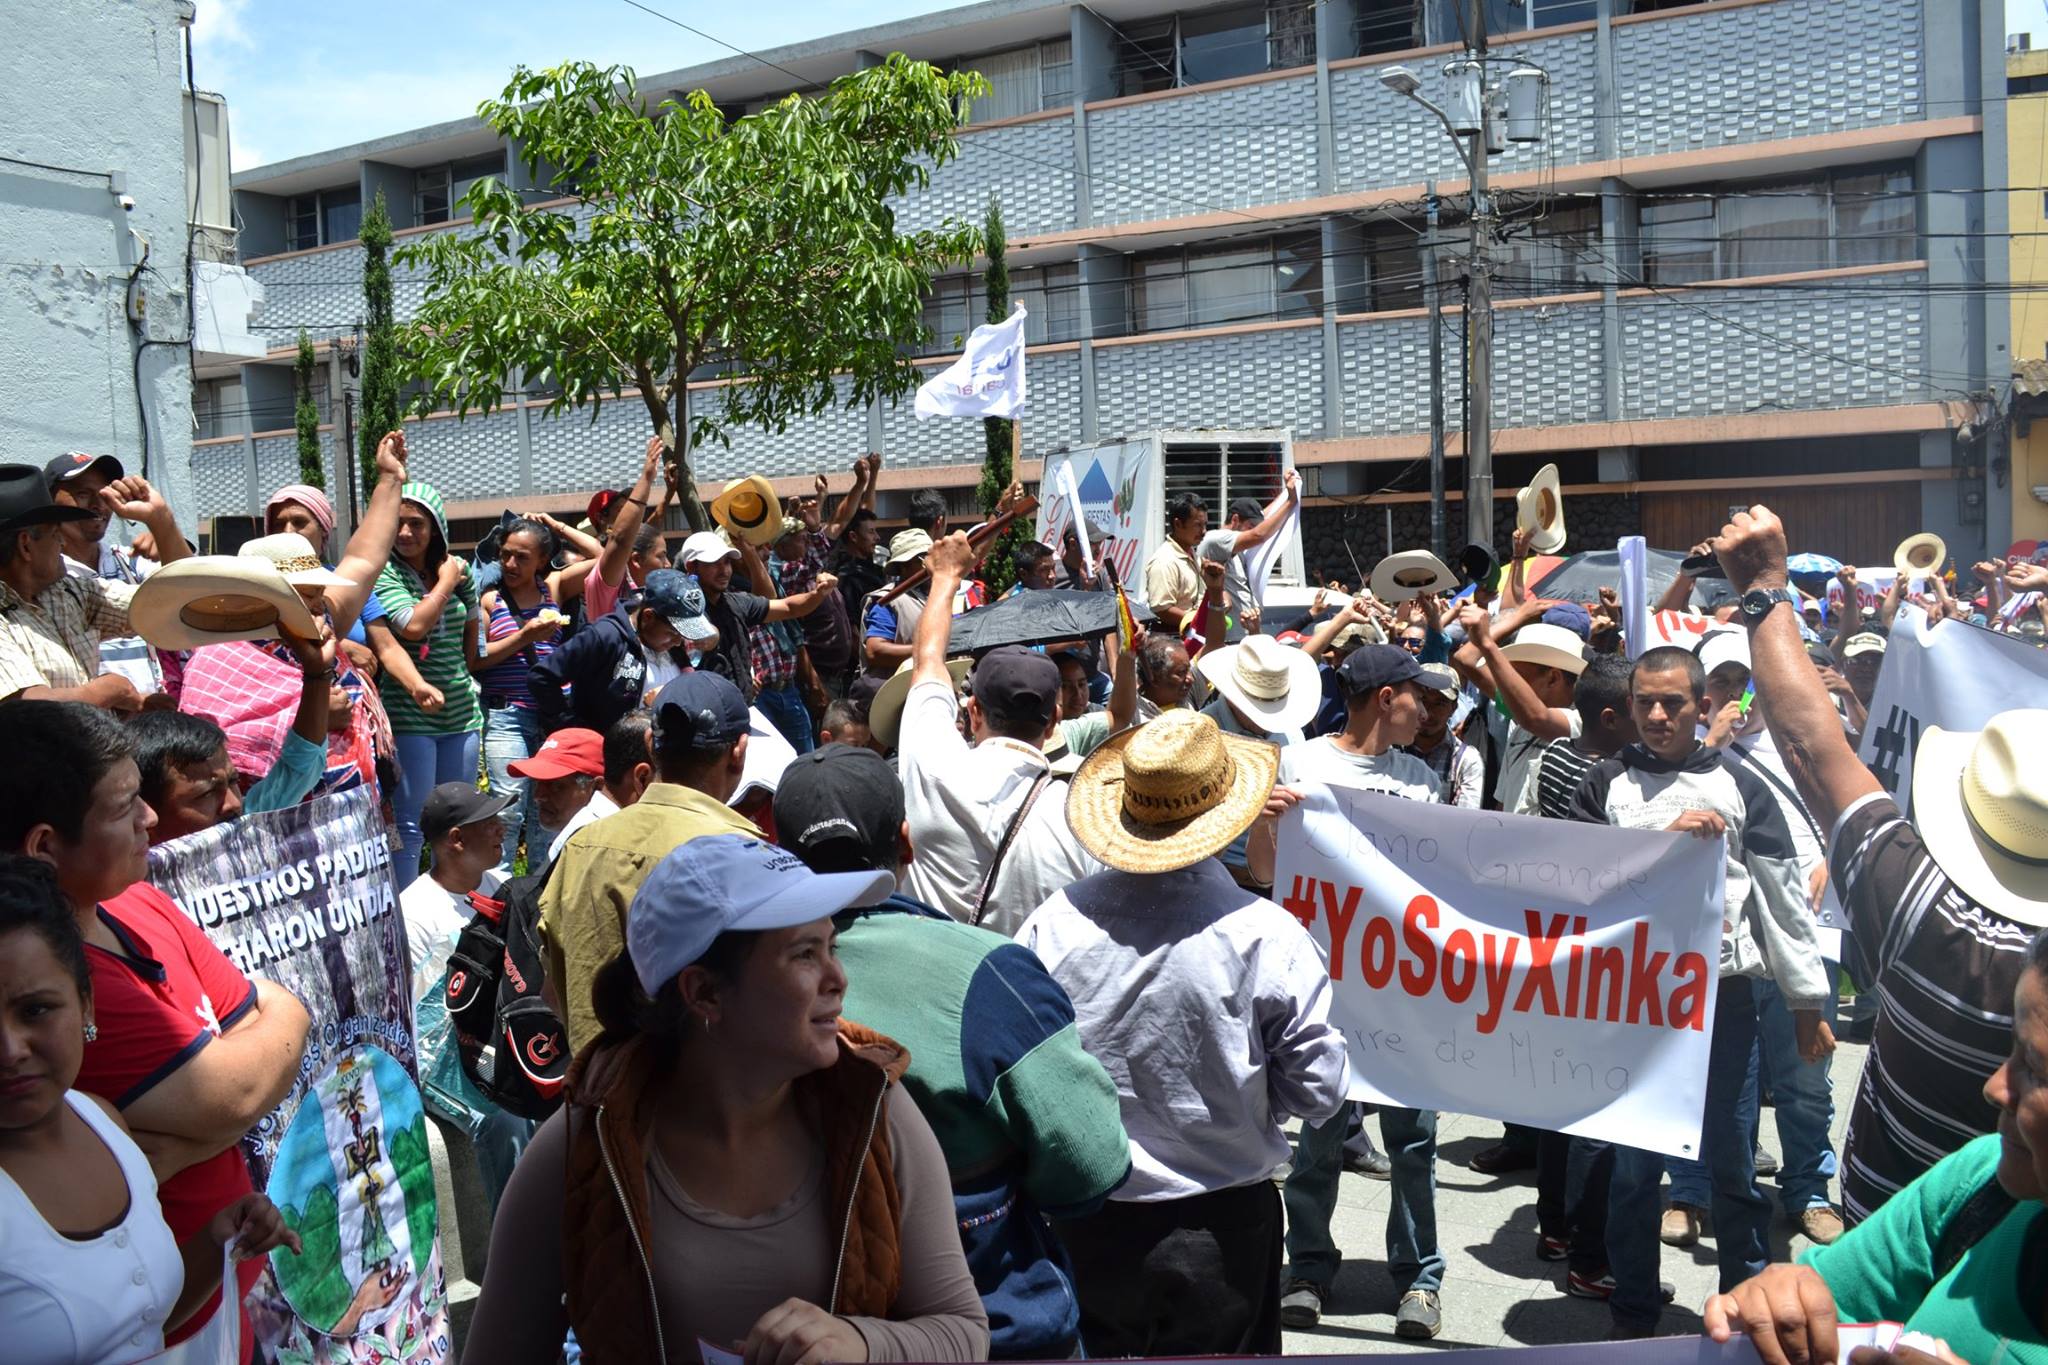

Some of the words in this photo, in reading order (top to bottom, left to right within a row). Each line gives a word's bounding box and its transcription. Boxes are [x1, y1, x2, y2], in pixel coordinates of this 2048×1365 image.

[2007, 554, 2037, 565] Clar
[175, 858, 315, 928] NUESTROS
[315, 832, 391, 886] PADRES
[1466, 816, 1648, 902] Grande
[215, 906, 327, 975] CHARON
[327, 896, 366, 936] UN
[365, 881, 396, 922] DIA
[1282, 873, 1708, 1034] #YoSoyXinka
[1435, 1027, 1478, 1070] de
[1509, 1030, 1629, 1096] Mina
